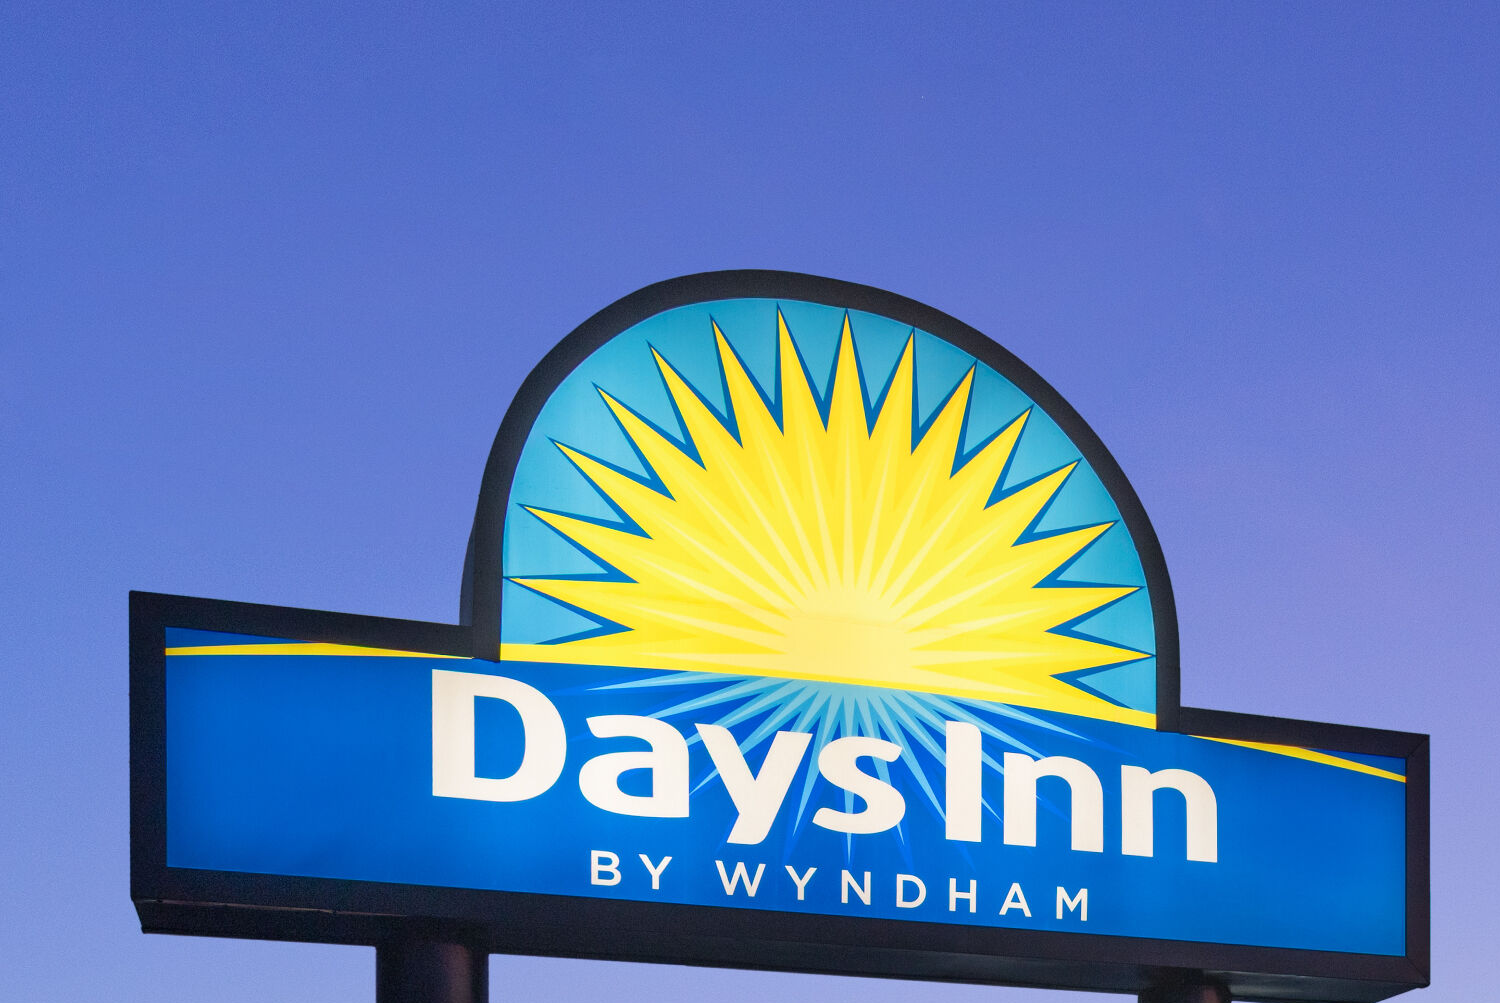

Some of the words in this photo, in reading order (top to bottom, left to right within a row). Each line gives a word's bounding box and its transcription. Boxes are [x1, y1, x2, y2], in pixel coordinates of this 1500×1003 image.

[432, 669, 907, 845] Days
[945, 720, 1218, 863] Inn
[590, 849, 673, 891] BY
[715, 859, 1089, 922] WYNDHAM
